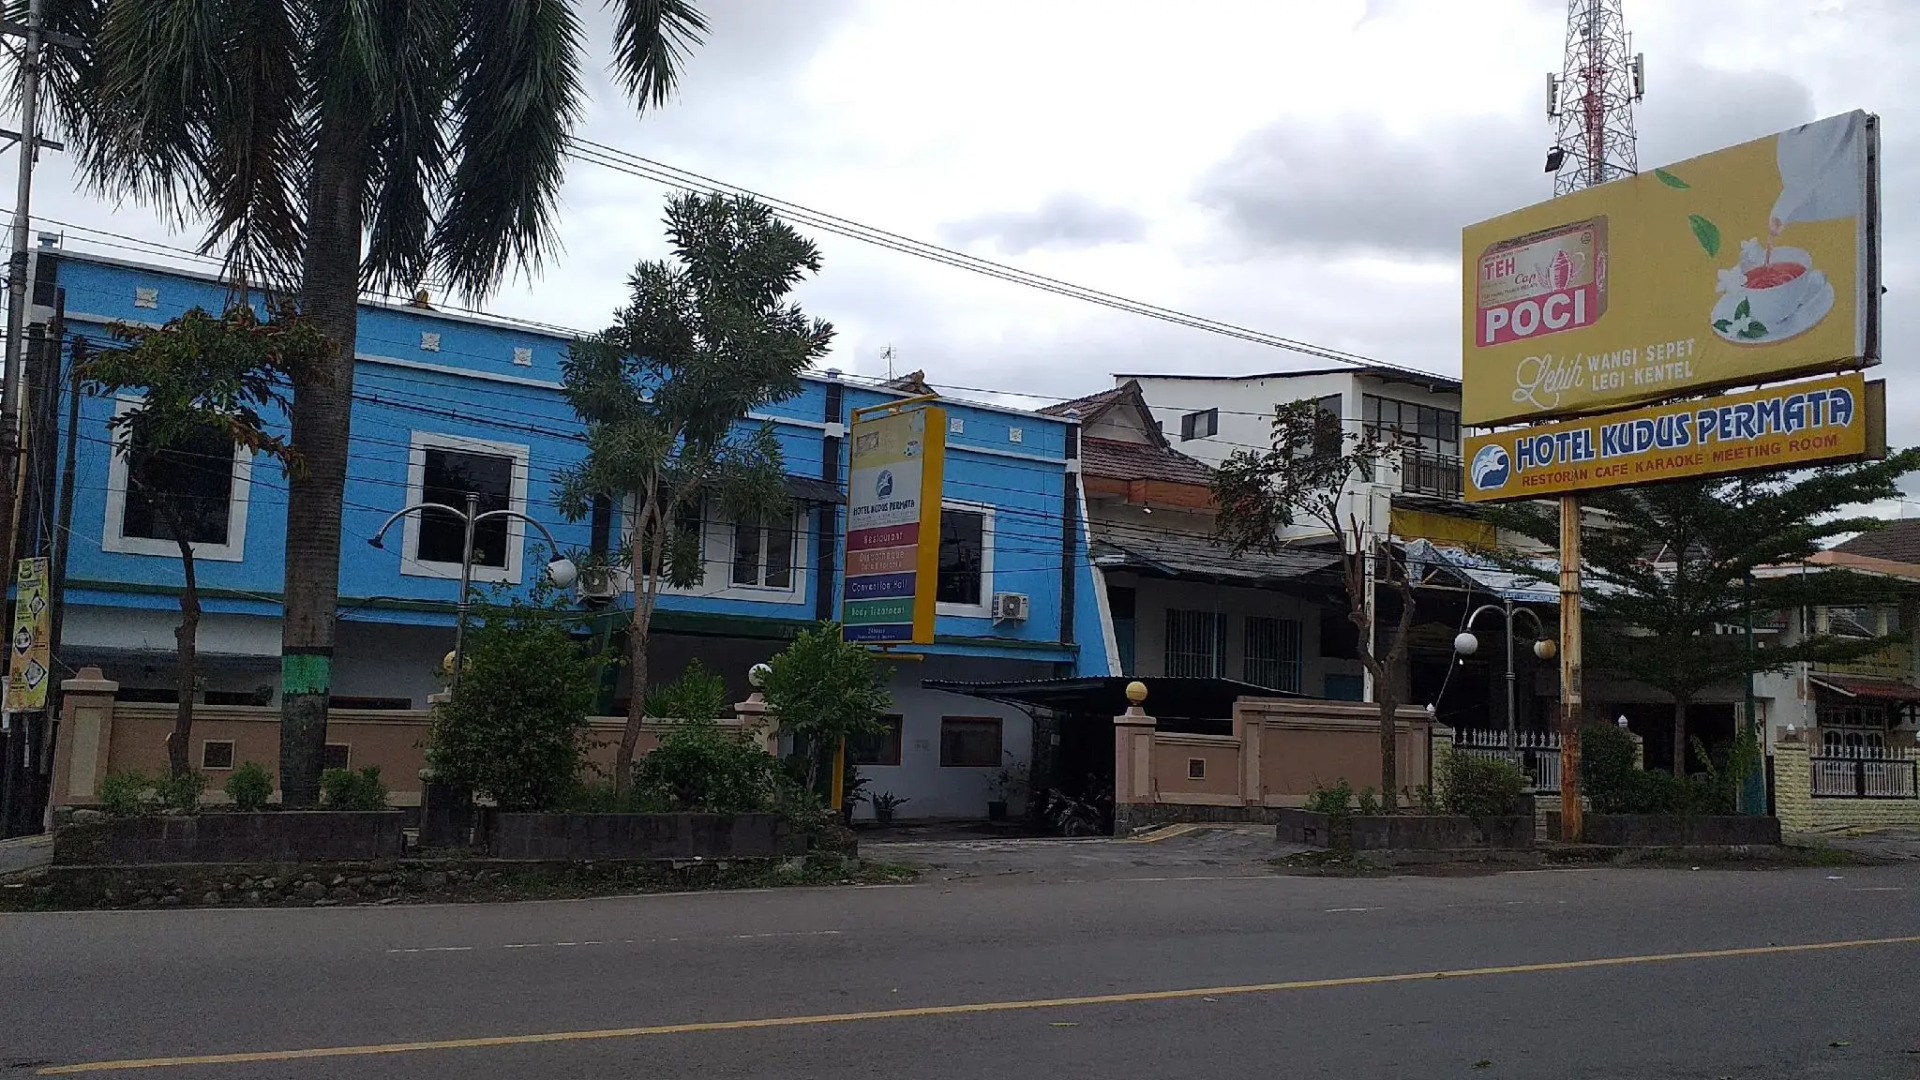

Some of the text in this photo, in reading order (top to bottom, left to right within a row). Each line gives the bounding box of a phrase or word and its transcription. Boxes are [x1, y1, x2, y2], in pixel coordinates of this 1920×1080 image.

[1484, 257, 1516, 281] TEH
[1515, 272, 1537, 285] Cap
[1485, 289, 1585, 343] POCI
[1587, 338, 1696, 373] WANGI SEPET
[1512, 353, 1584, 411] Lebih
[1592, 360, 1693, 392] LEGI KENTEL
[1516, 386, 1855, 474] HOTEL KUDUS PERMATA
[1522, 433, 1838, 488] RESTORAN CAFE KARAOKE MEETING ROOM
[852, 581, 891, 593] Convention
[870, 605, 905, 616] Treatment
